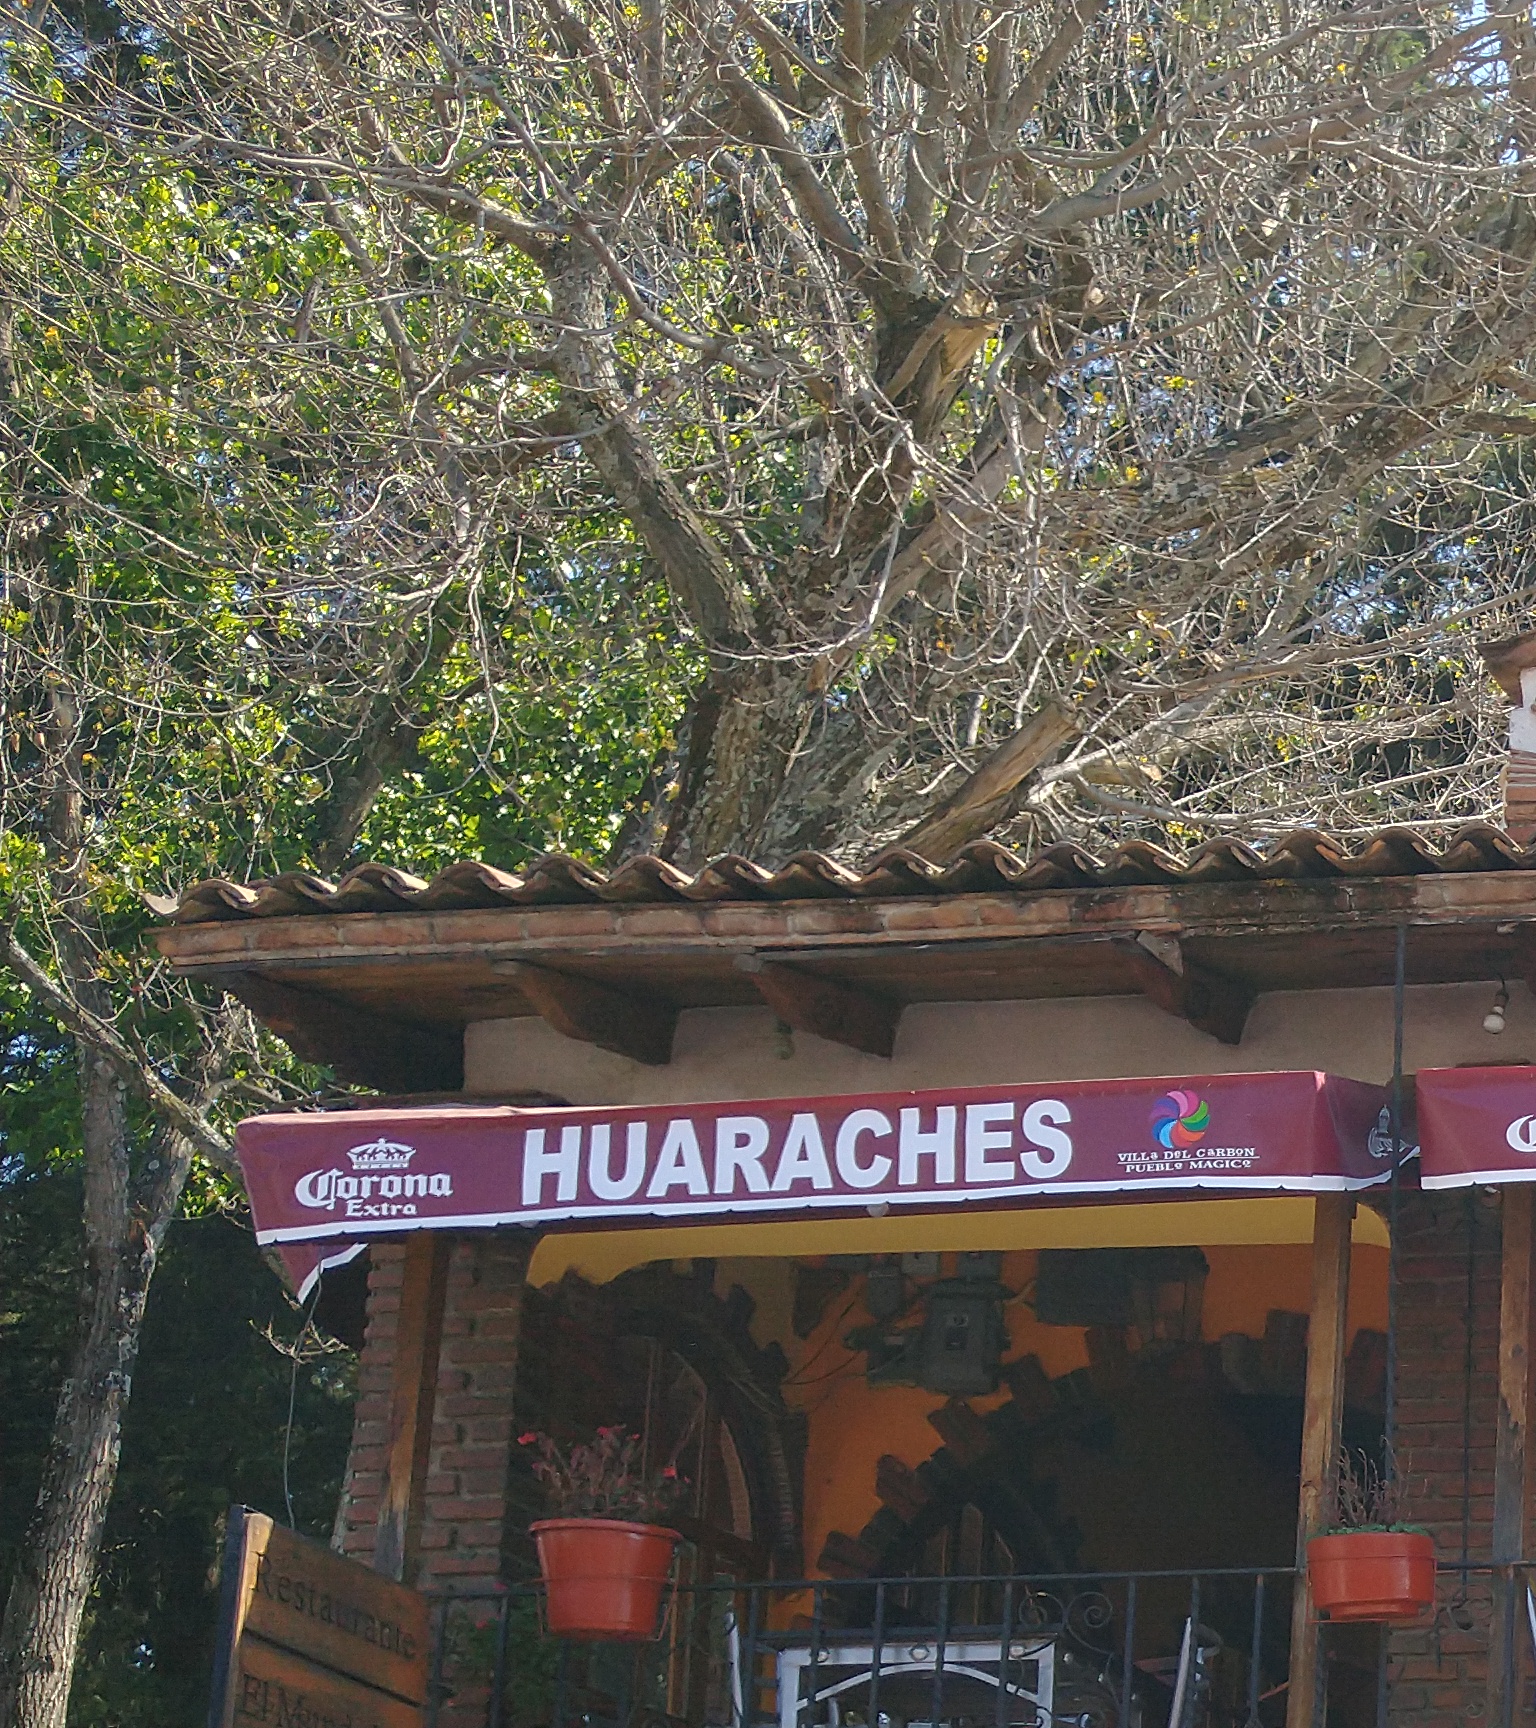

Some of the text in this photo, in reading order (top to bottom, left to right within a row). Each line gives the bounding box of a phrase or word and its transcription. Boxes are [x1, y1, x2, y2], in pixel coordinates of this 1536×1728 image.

[521, 1098, 1073, 1205] HUARACHES
[295, 1168, 454, 1211] Corona
[344, 1198, 417, 1218] Extra
[255, 1555, 416, 1659] Restaurante
